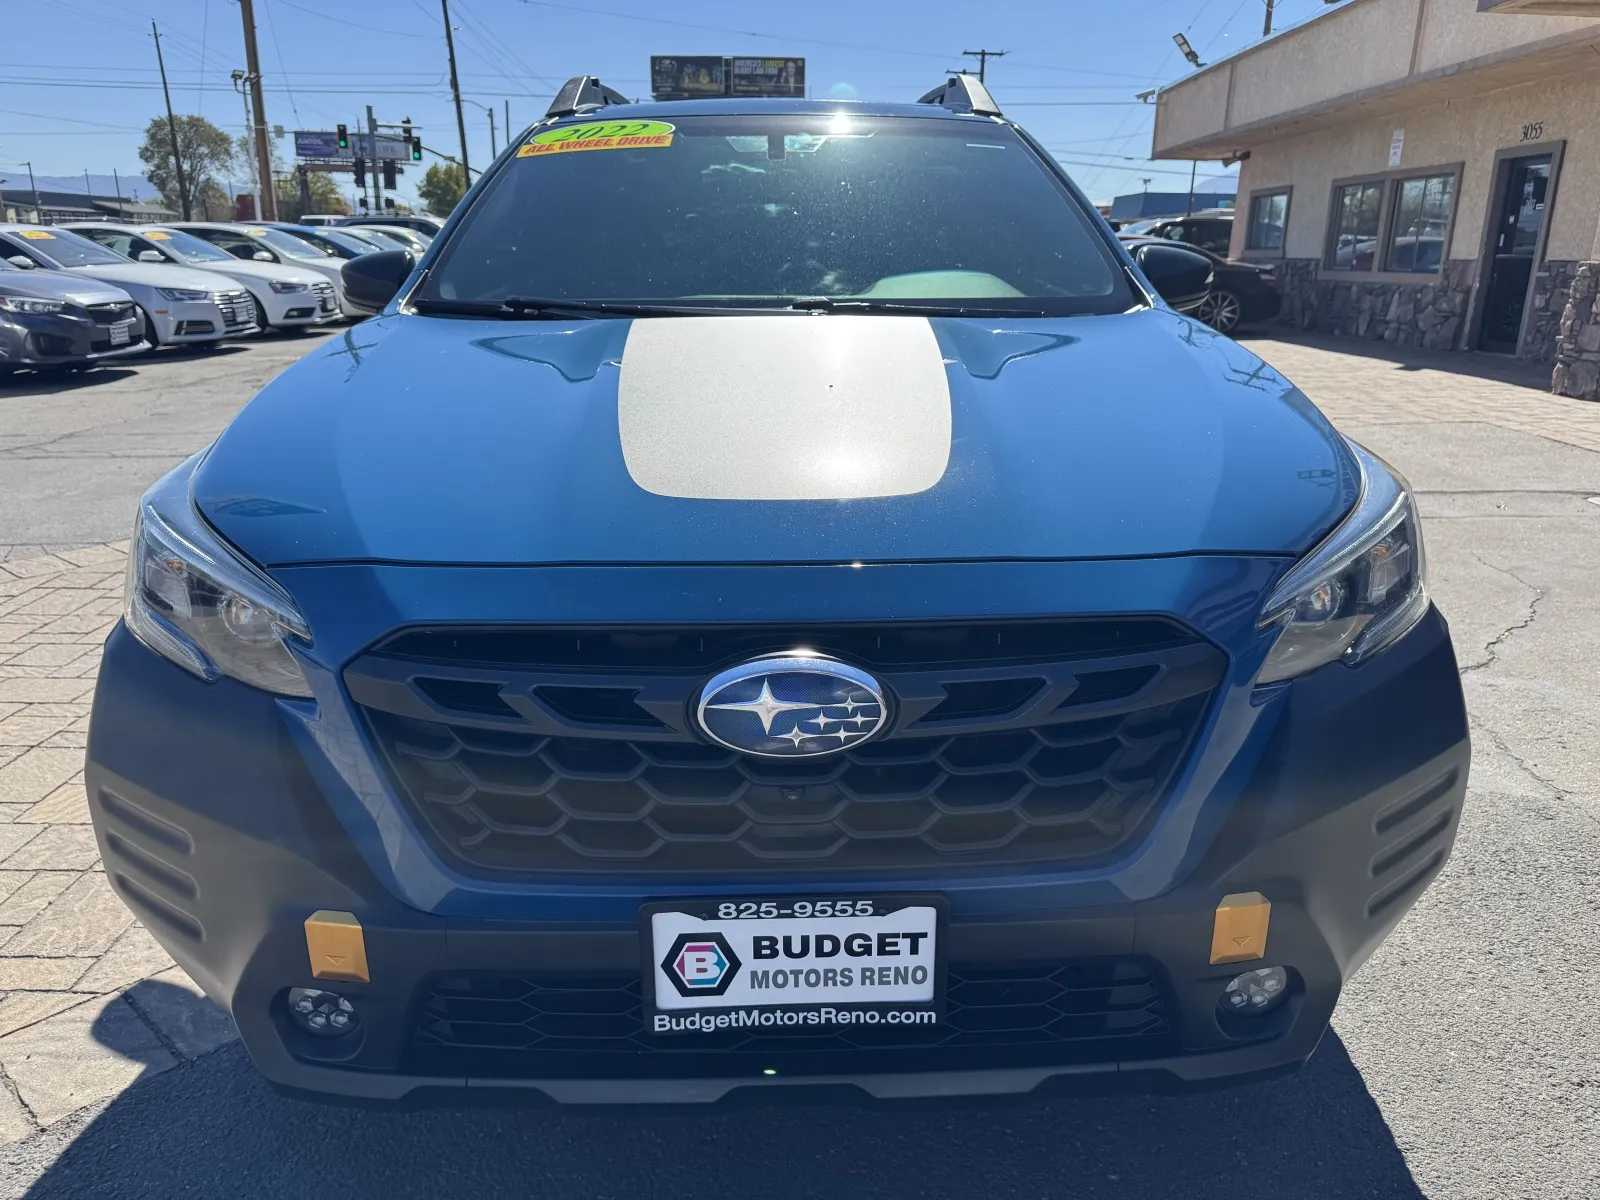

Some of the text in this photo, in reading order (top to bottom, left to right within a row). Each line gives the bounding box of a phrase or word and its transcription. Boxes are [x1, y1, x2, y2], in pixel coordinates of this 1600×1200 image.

[551, 123, 650, 141] 2022
[1519, 121, 1544, 142] 3055
[524, 135, 669, 155] ALL WHEEL DRIVE
[717, 900, 874, 919] 825-9555
[752, 932, 929, 960] BUDGET
[750, 965, 929, 990] MOTORS RENO
[653, 1007, 937, 1033] BudgetMotorsReno.com
